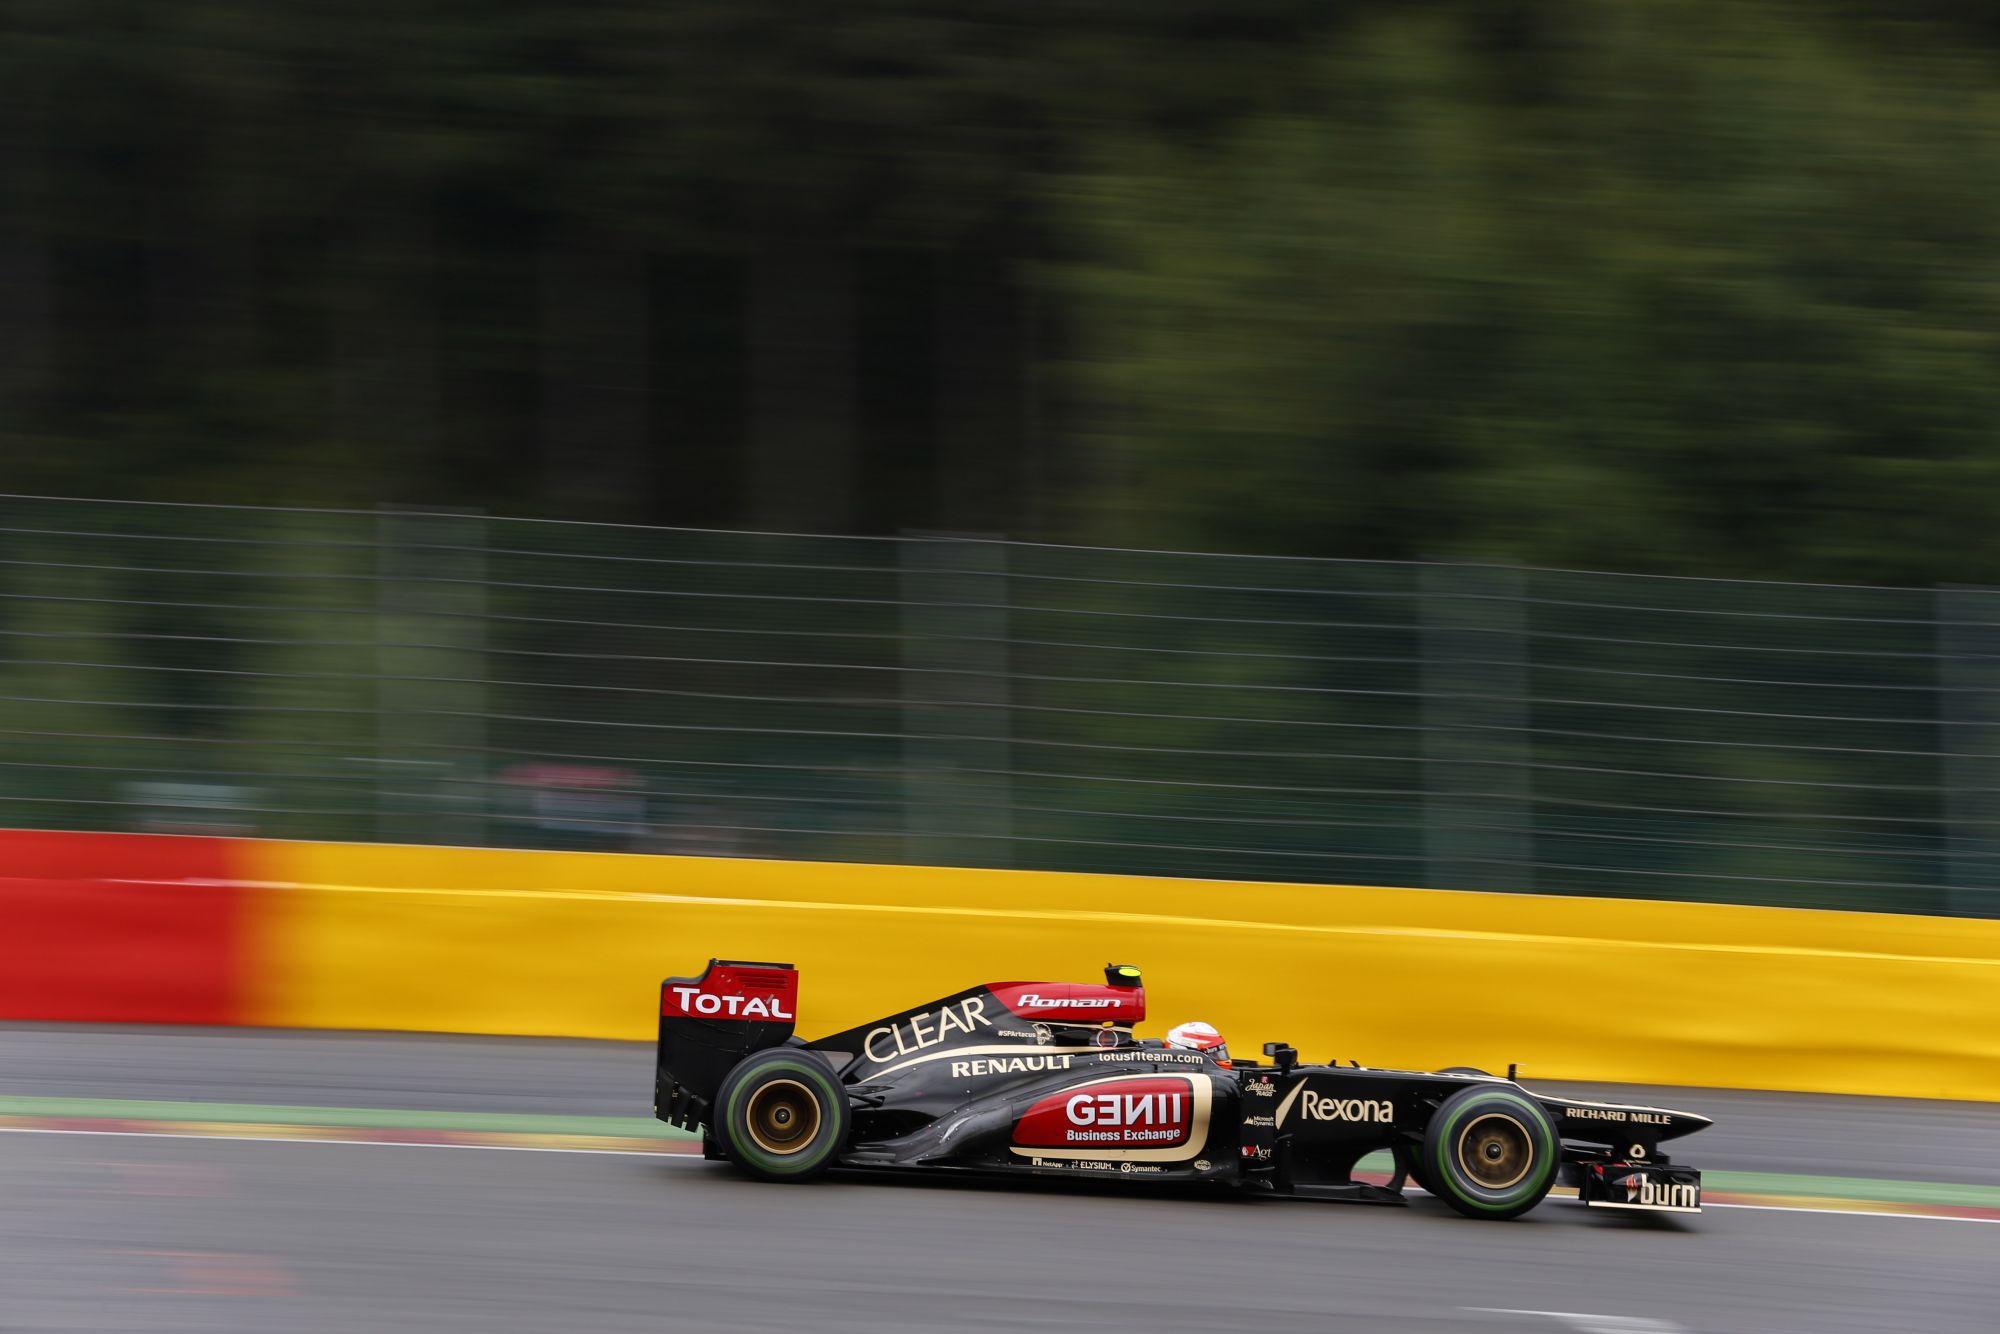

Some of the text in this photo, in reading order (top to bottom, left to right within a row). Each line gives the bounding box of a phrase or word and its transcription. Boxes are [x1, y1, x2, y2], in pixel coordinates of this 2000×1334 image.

[673, 987, 792, 1019] TOTAL
[1017, 994, 1121, 1008] Romain
[864, 996, 992, 1063] CLEAR
[951, 1054, 1075, 1077] RENAULT
[1099, 1051, 1203, 1065] lotusf1team.com
[1302, 1090, 1393, 1123] Rexona
[1566, 1107, 1671, 1125] RICHARD MILLE
[1066, 1128, 1181, 1141] Business Exchange
[1131, 1164, 1161, 1173] Symantec
[1640, 1172, 1696, 1207] burn
